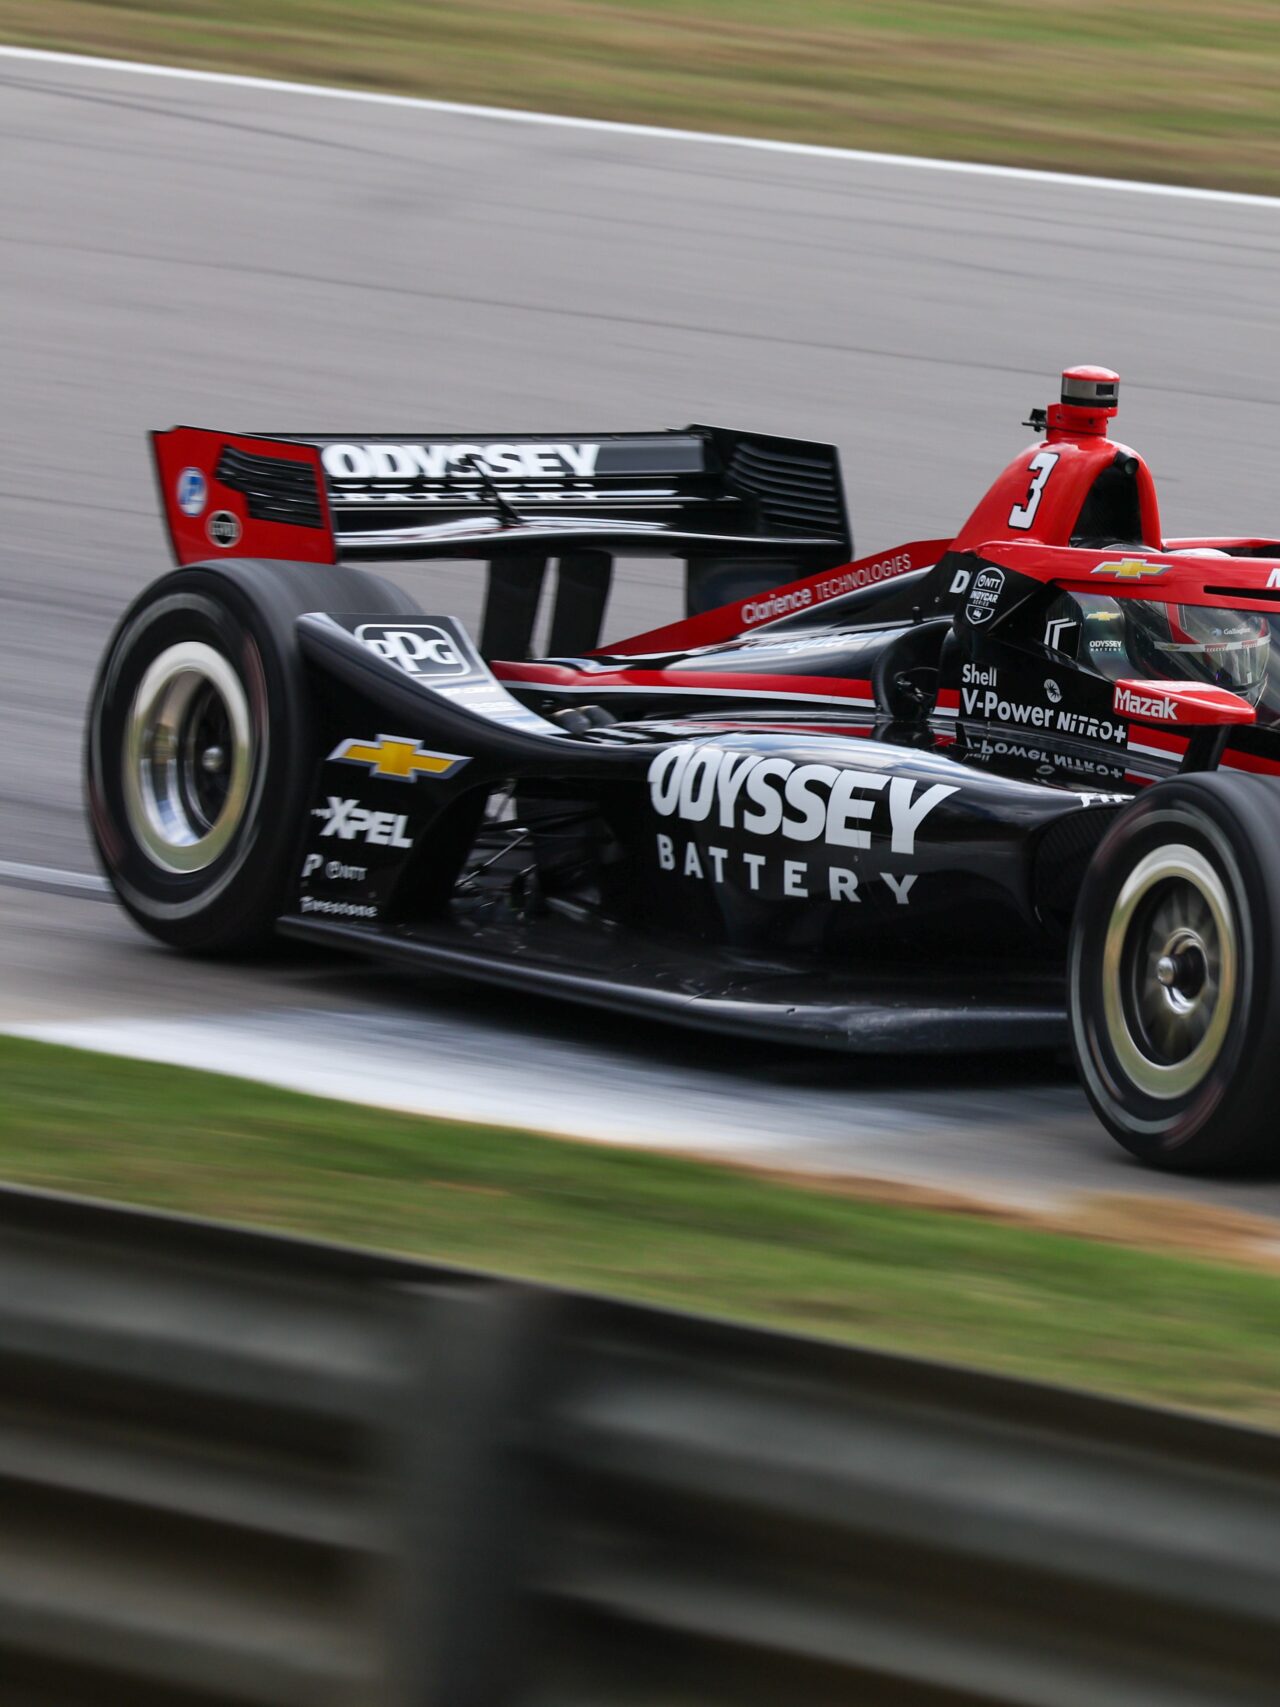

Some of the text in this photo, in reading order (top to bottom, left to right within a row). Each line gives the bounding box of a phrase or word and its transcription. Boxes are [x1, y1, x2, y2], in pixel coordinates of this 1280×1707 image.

[321, 444, 600, 478] ODYSSEY
[1009, 453, 1059, 530] 3
[741, 553, 912, 624] Clarience TECHNOLOGIES
[949, 569, 971, 594] D
[983, 576, 1001, 589] NTT
[1089, 640, 1122, 648] ODYSSEY
[962, 663, 998, 687] Shell
[961, 687, 1054, 728] V-Power
[1114, 687, 1179, 720] Mazak
[647, 744, 962, 856] ODYSSEY
[319, 796, 414, 849] XPEL
[656, 833, 919, 905] BATTERY
